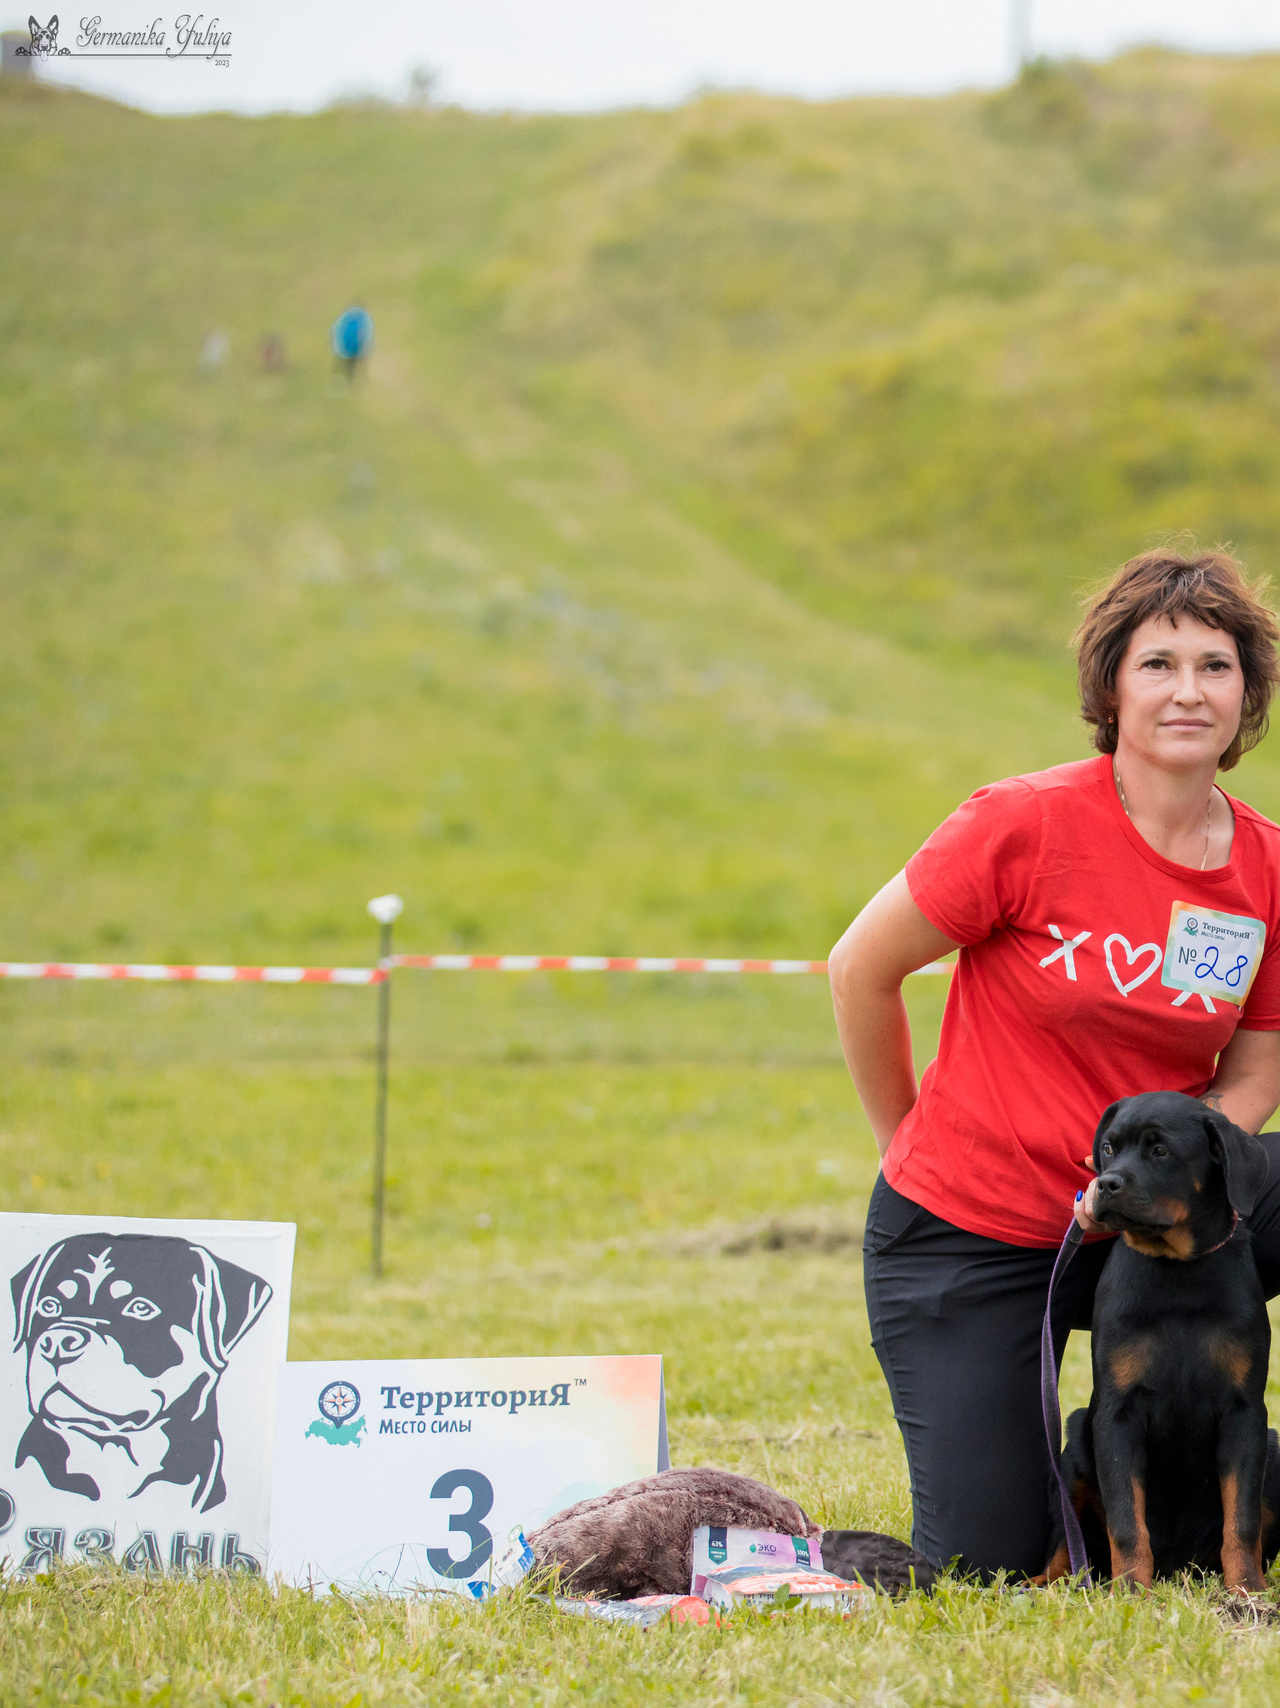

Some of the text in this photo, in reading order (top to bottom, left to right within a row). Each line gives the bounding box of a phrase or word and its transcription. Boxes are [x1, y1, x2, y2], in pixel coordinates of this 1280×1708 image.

[1194, 946, 1249, 987] 28
[426, 1468, 495, 1579] 3
[757, 1543, 777, 1553] ЭКО
